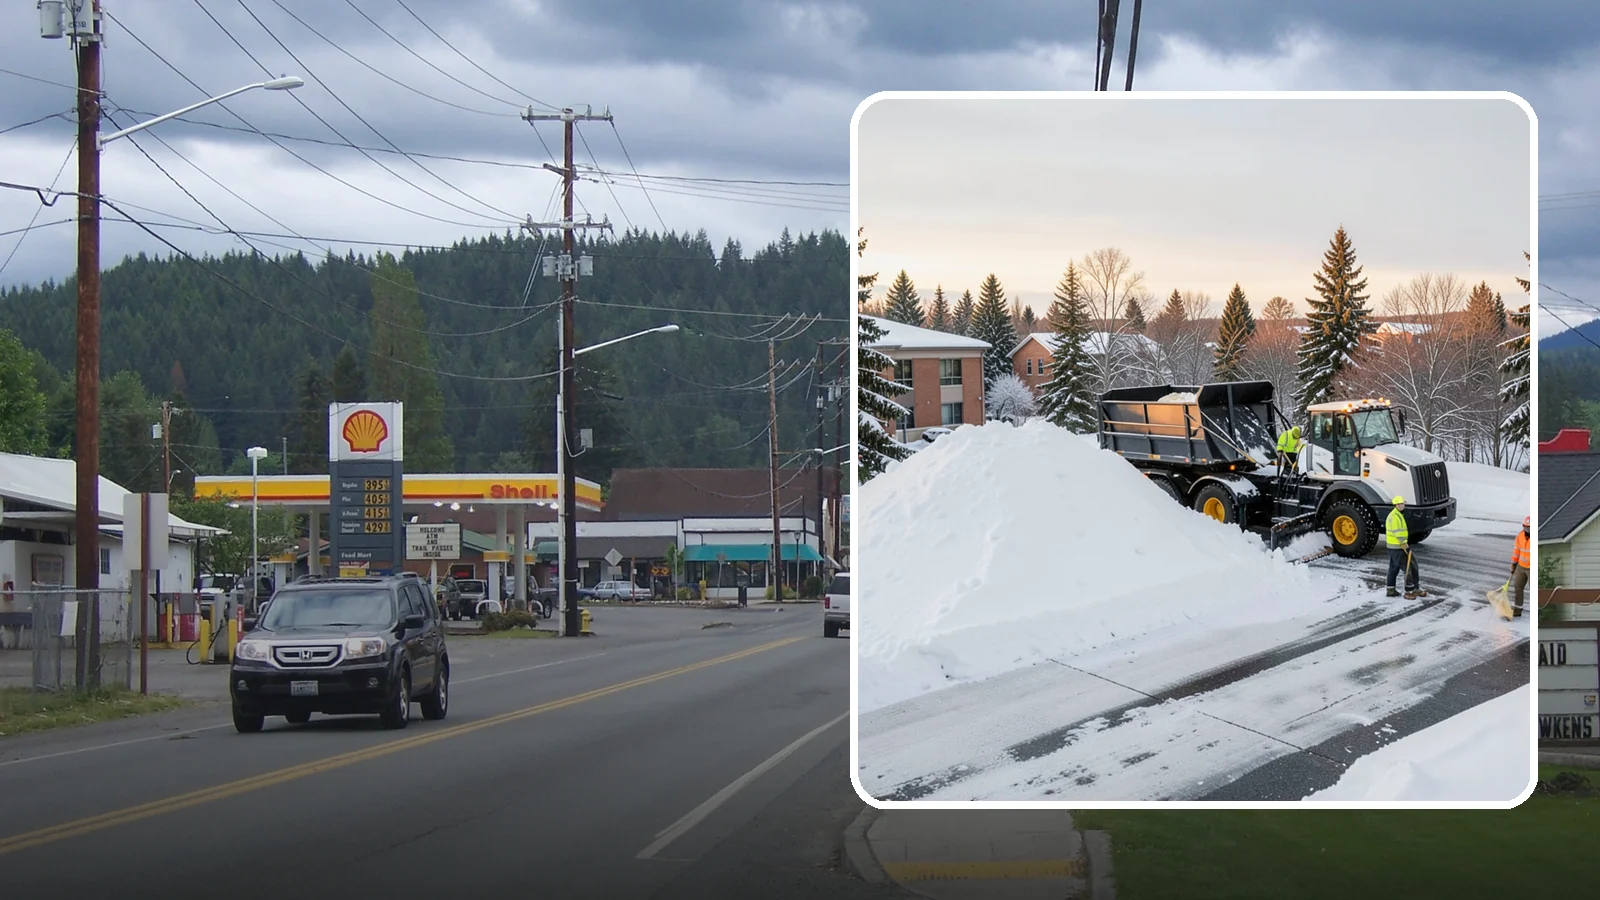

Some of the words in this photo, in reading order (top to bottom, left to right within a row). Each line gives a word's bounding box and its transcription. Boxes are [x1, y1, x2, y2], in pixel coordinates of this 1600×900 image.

[366, 480, 383, 490] 395
[490, 484, 547, 499] Shell
[366, 494, 383, 504] 405
[366, 508, 383, 518] 415
[366, 522, 383, 532] 429
